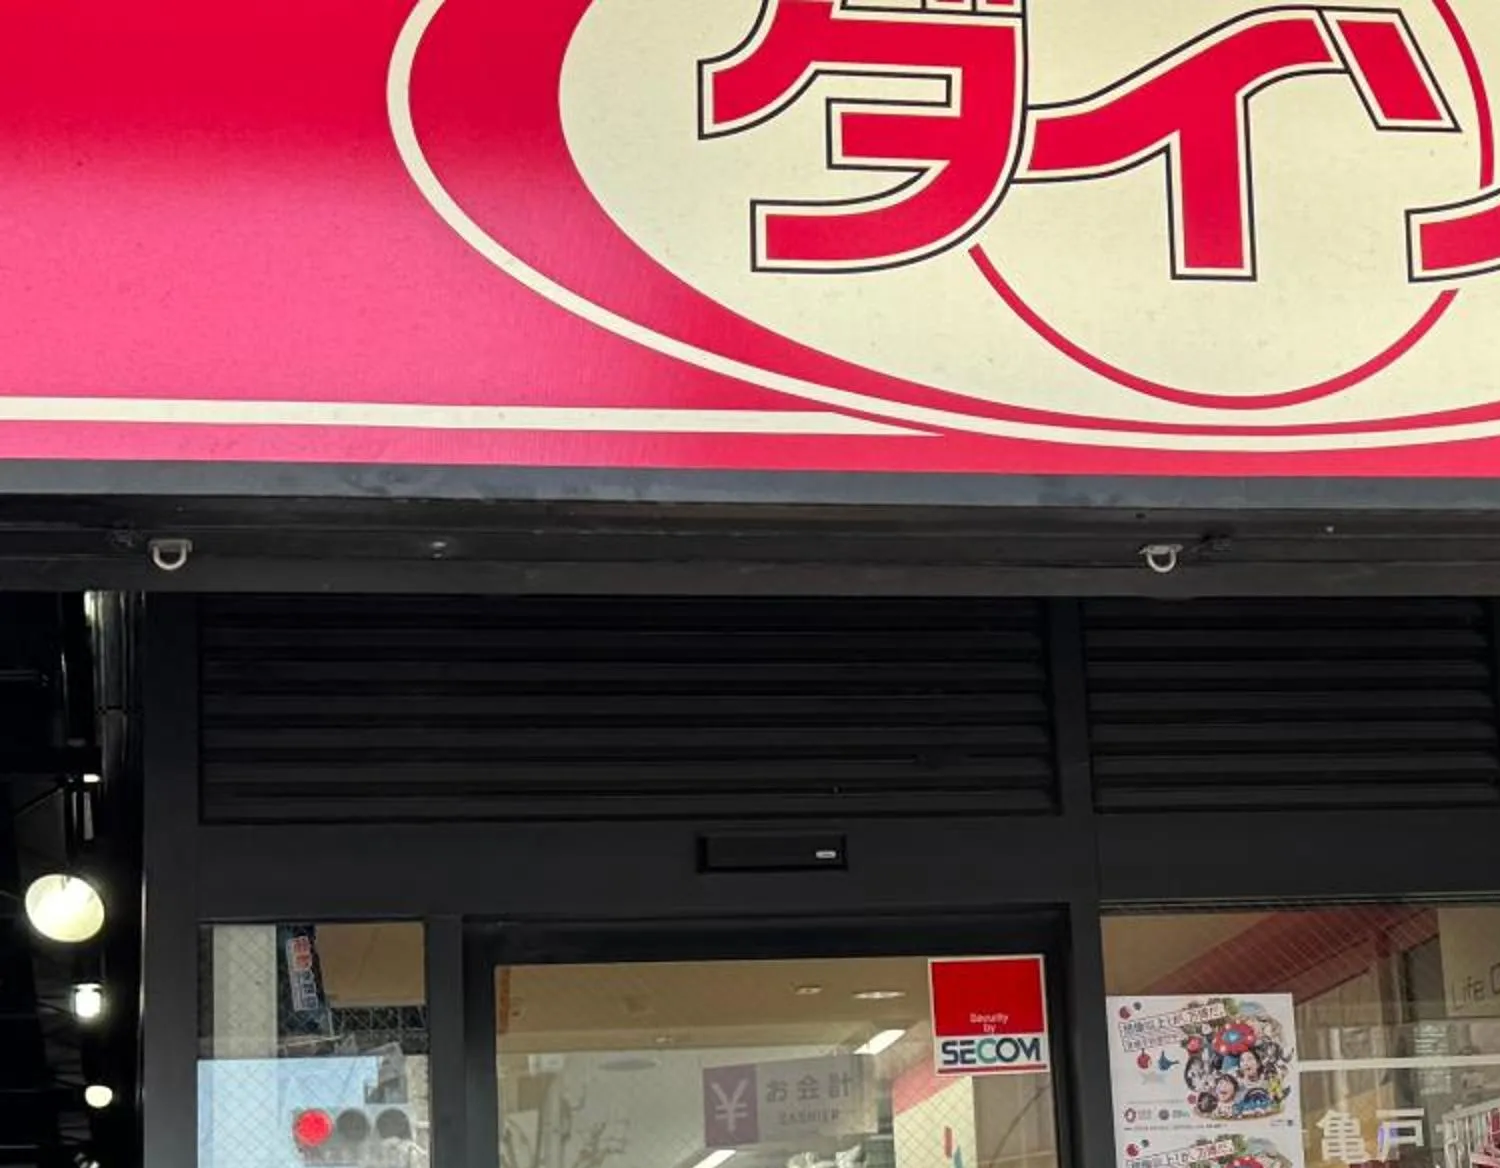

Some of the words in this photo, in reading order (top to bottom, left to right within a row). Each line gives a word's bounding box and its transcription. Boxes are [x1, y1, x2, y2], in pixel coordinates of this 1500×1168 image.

[1452, 975, 1485, 1010] Life
[983, 1023, 997, 1033] by
[941, 1037, 1042, 1065] SECOM
[765, 1071, 853, 1103] お会計
[1316, 1109, 1446, 1164] 亀戸
